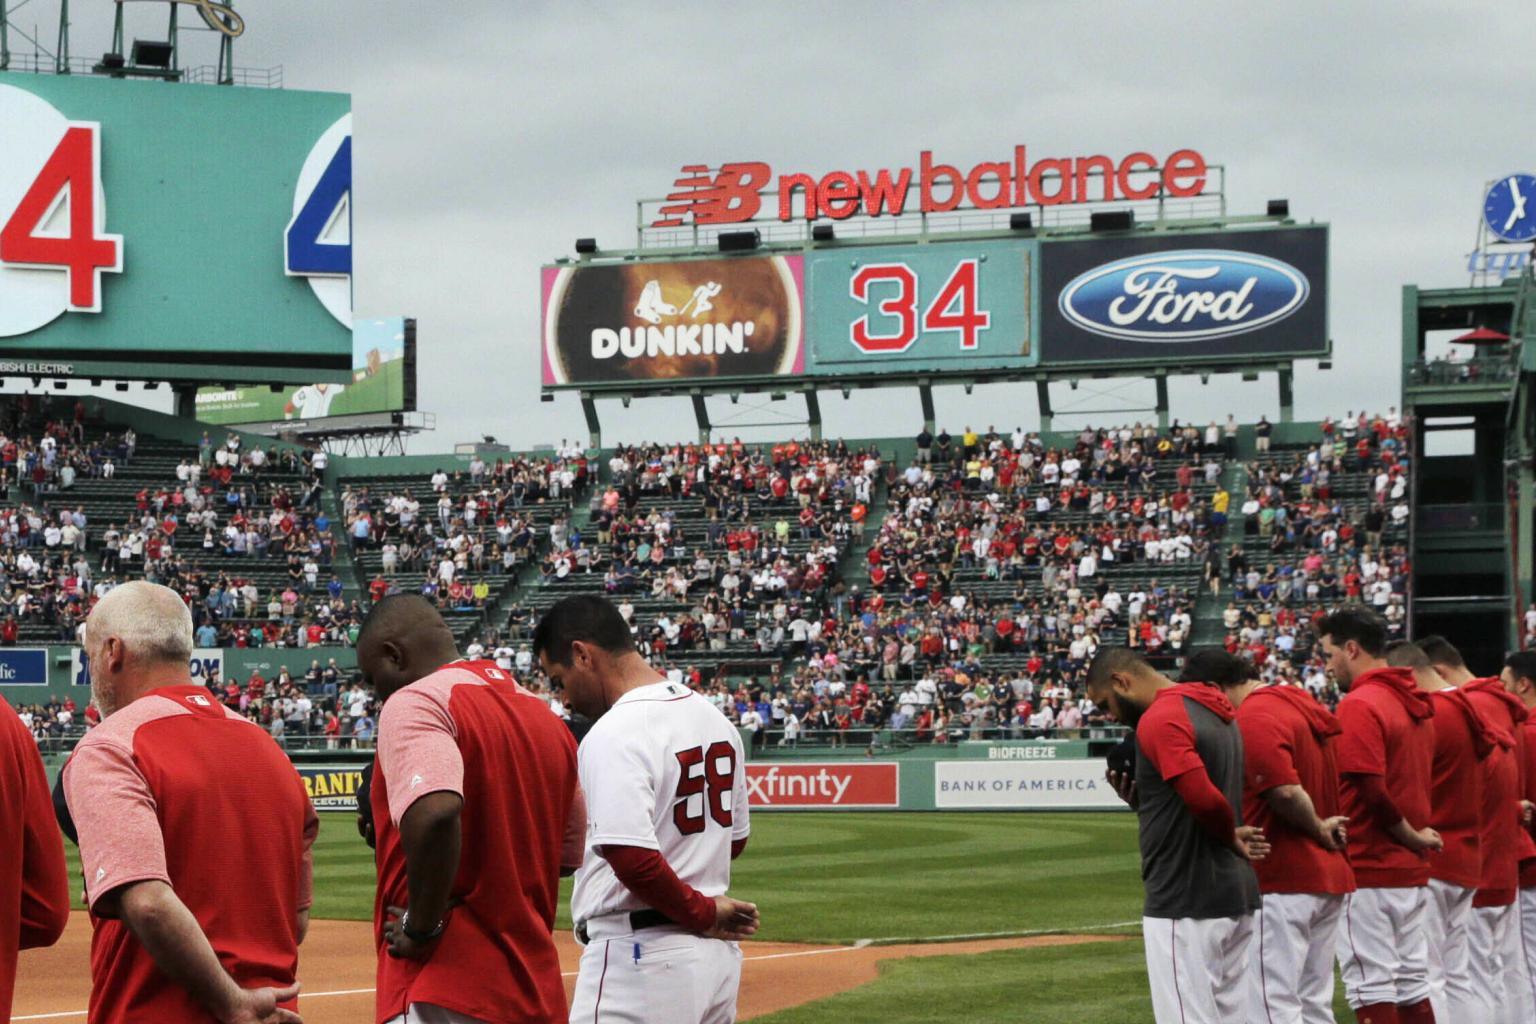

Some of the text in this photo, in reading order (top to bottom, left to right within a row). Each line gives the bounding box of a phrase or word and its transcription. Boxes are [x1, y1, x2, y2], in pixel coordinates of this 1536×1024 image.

[778, 144, 1207, 222] new balance
[849, 258, 990, 354] 34
[1109, 265, 1258, 325] Ford
[591, 321, 755, 359] DUNKIN'
[27, 363, 74, 374] ELECTRIC
[989, 747, 1056, 759] BIOFREEZE
[672, 740, 736, 836] 58
[746, 767, 852, 804] xfinity
[940, 779, 1097, 792] BANK OF AMERICA
